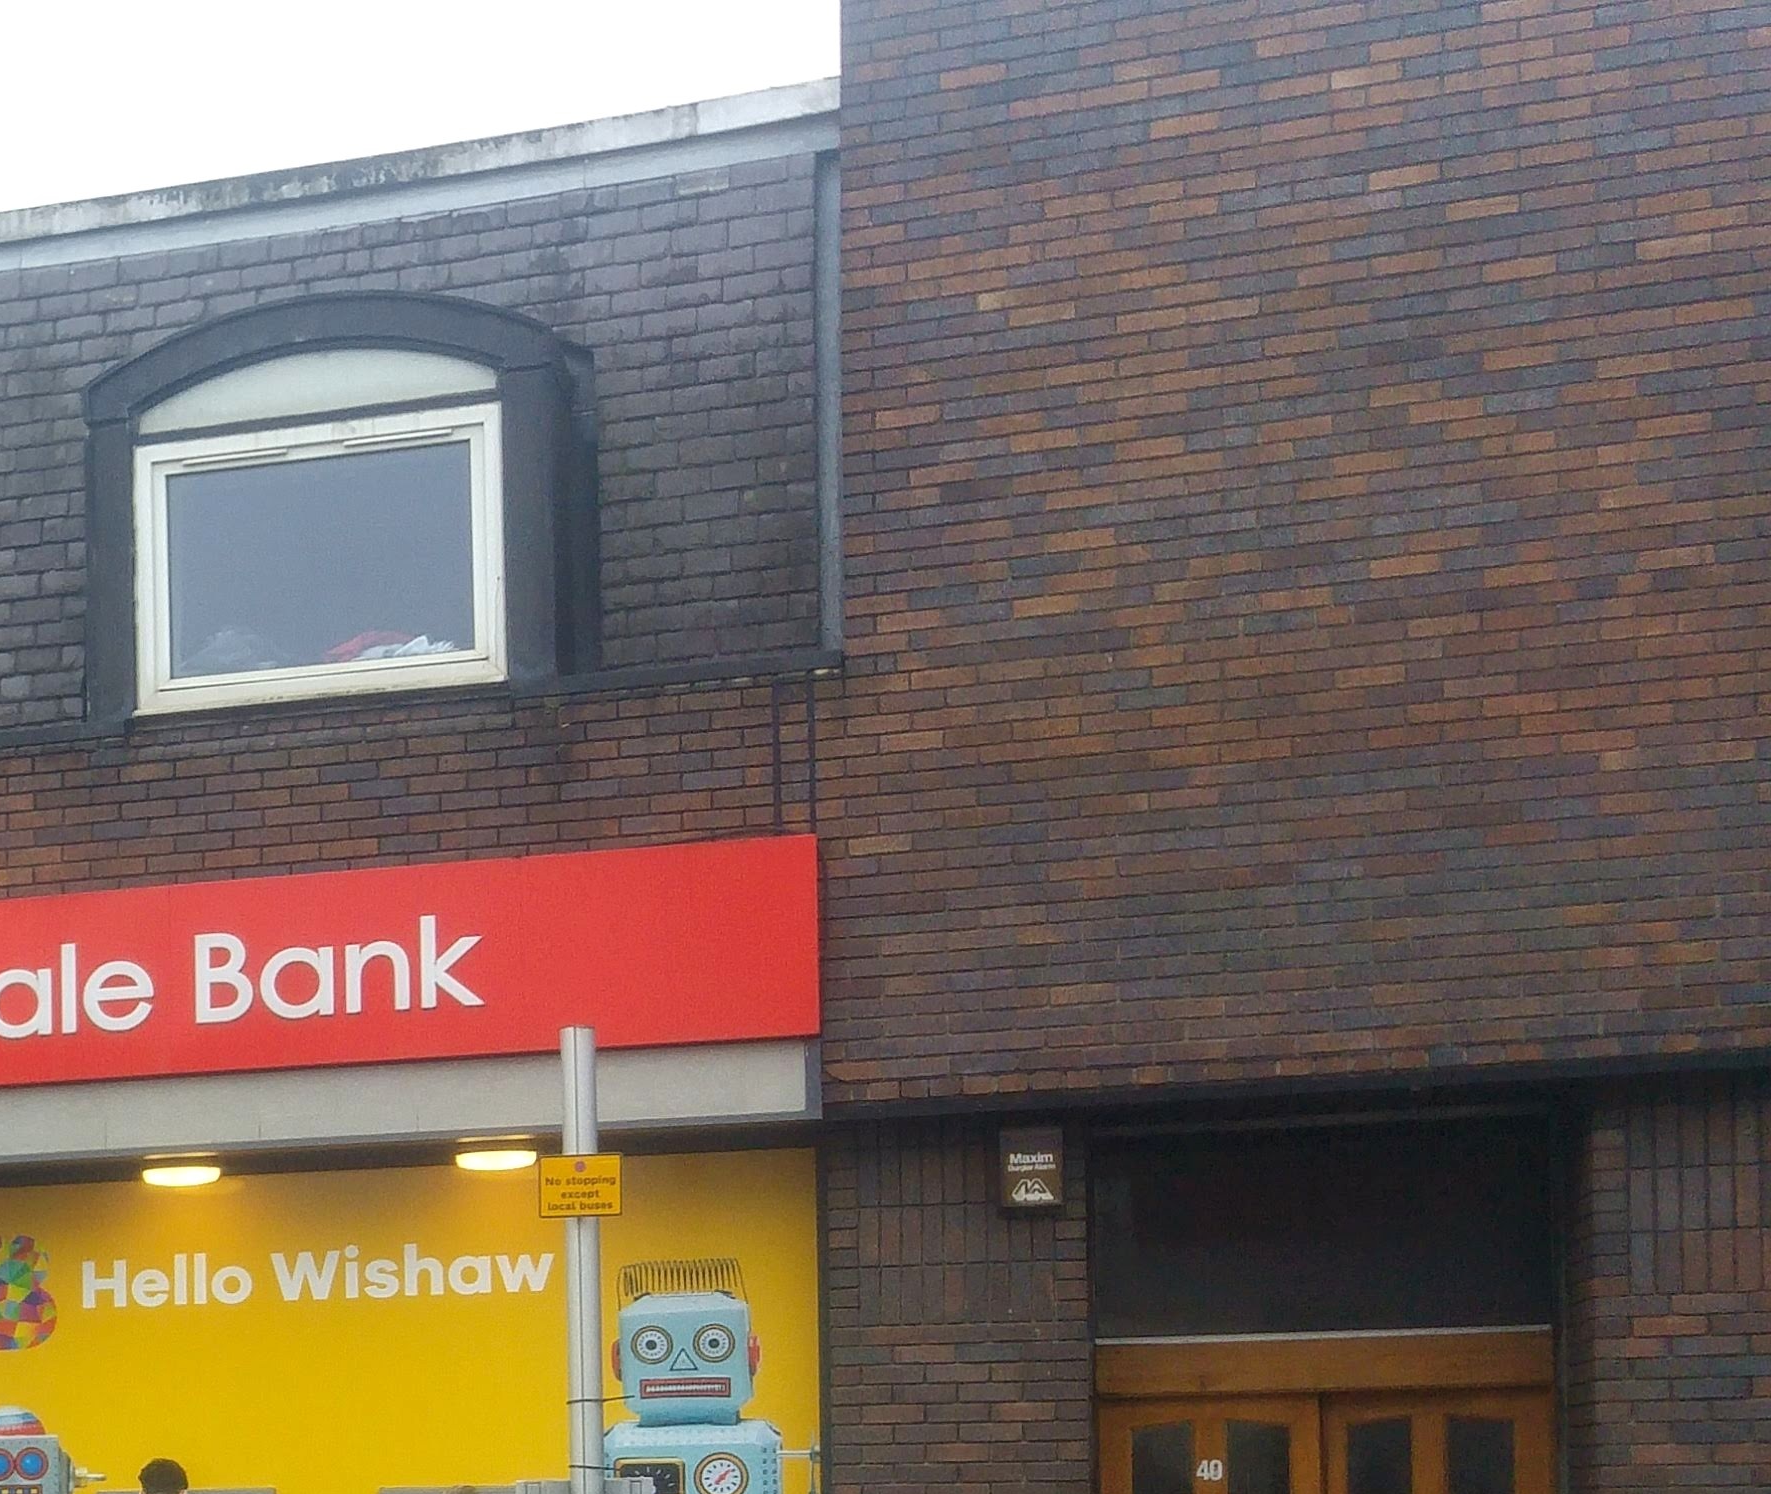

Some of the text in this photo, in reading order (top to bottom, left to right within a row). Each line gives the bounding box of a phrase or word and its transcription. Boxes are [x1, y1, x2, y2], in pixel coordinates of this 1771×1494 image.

[194, 913, 487, 1026] Bank
[1009, 1151, 1054, 1164] Maxim
[545, 1175, 617, 1186] No stopping
[561, 1190, 600, 1199] except
[547, 1201, 613, 1211] local buses
[81, 1242, 555, 1310] Hello Wishaw
